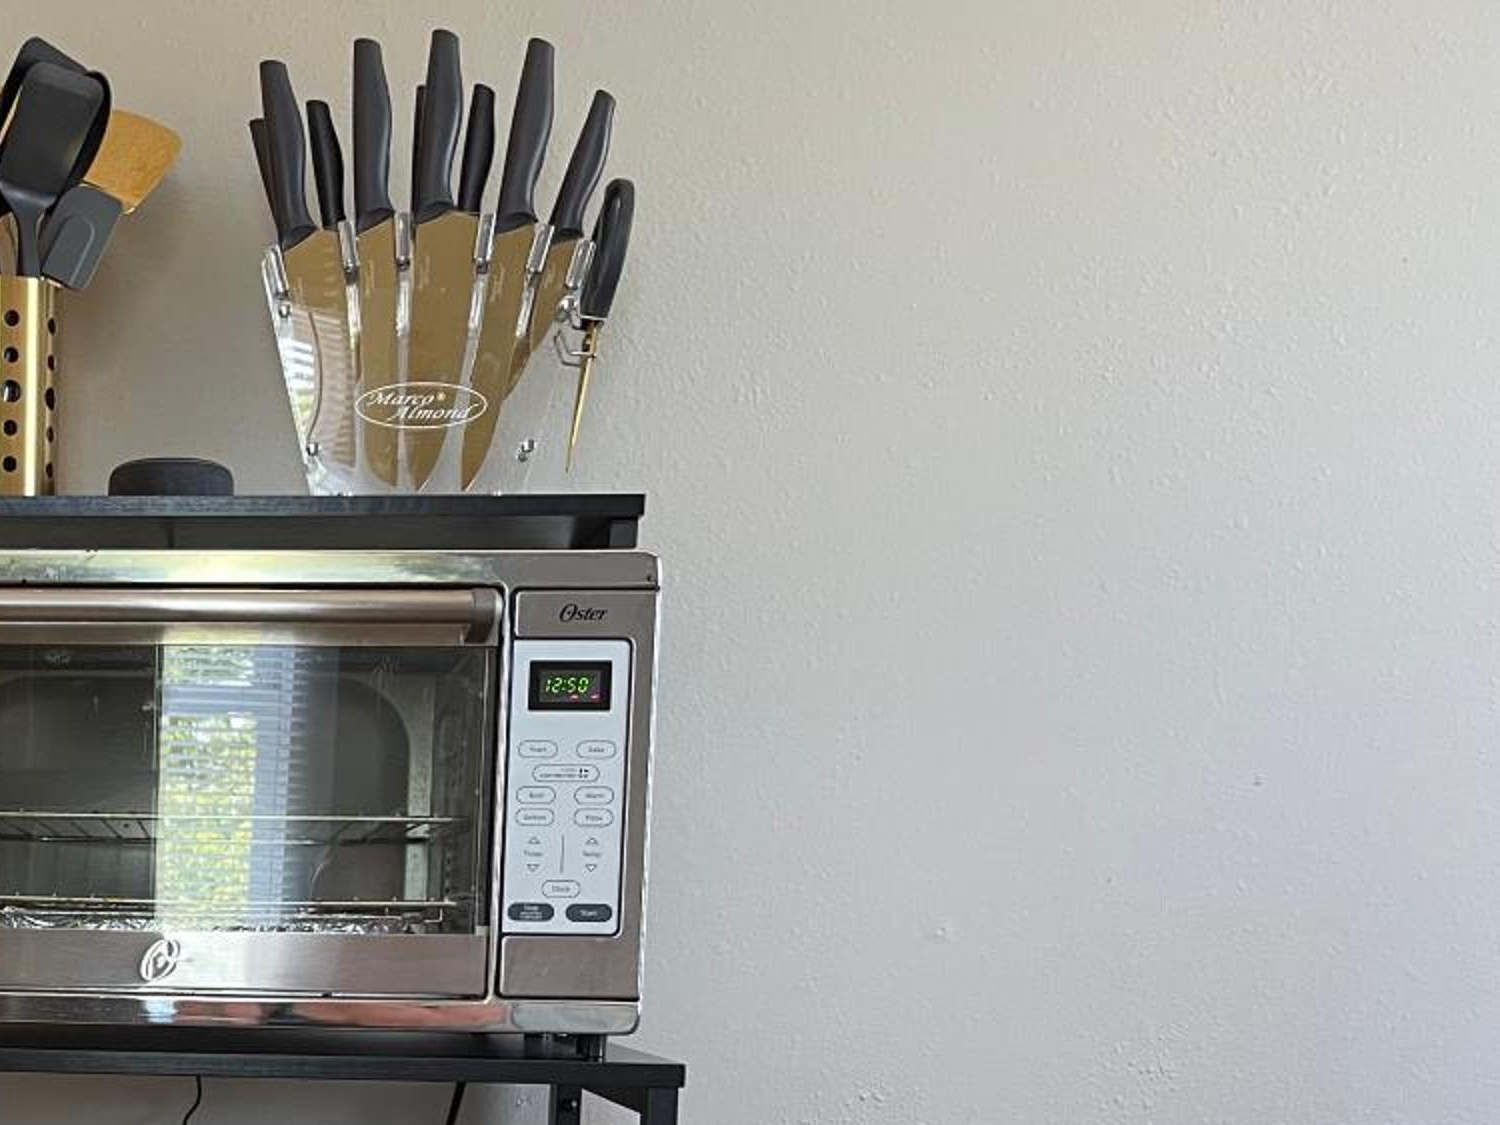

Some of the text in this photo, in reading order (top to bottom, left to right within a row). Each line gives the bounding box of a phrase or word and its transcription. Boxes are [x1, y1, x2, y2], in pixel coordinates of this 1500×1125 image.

[367, 391, 435, 406] Marco
[388, 403, 479, 421] Almond
[558, 602, 609, 623] Oster
[544, 676, 590, 693] 12:50
